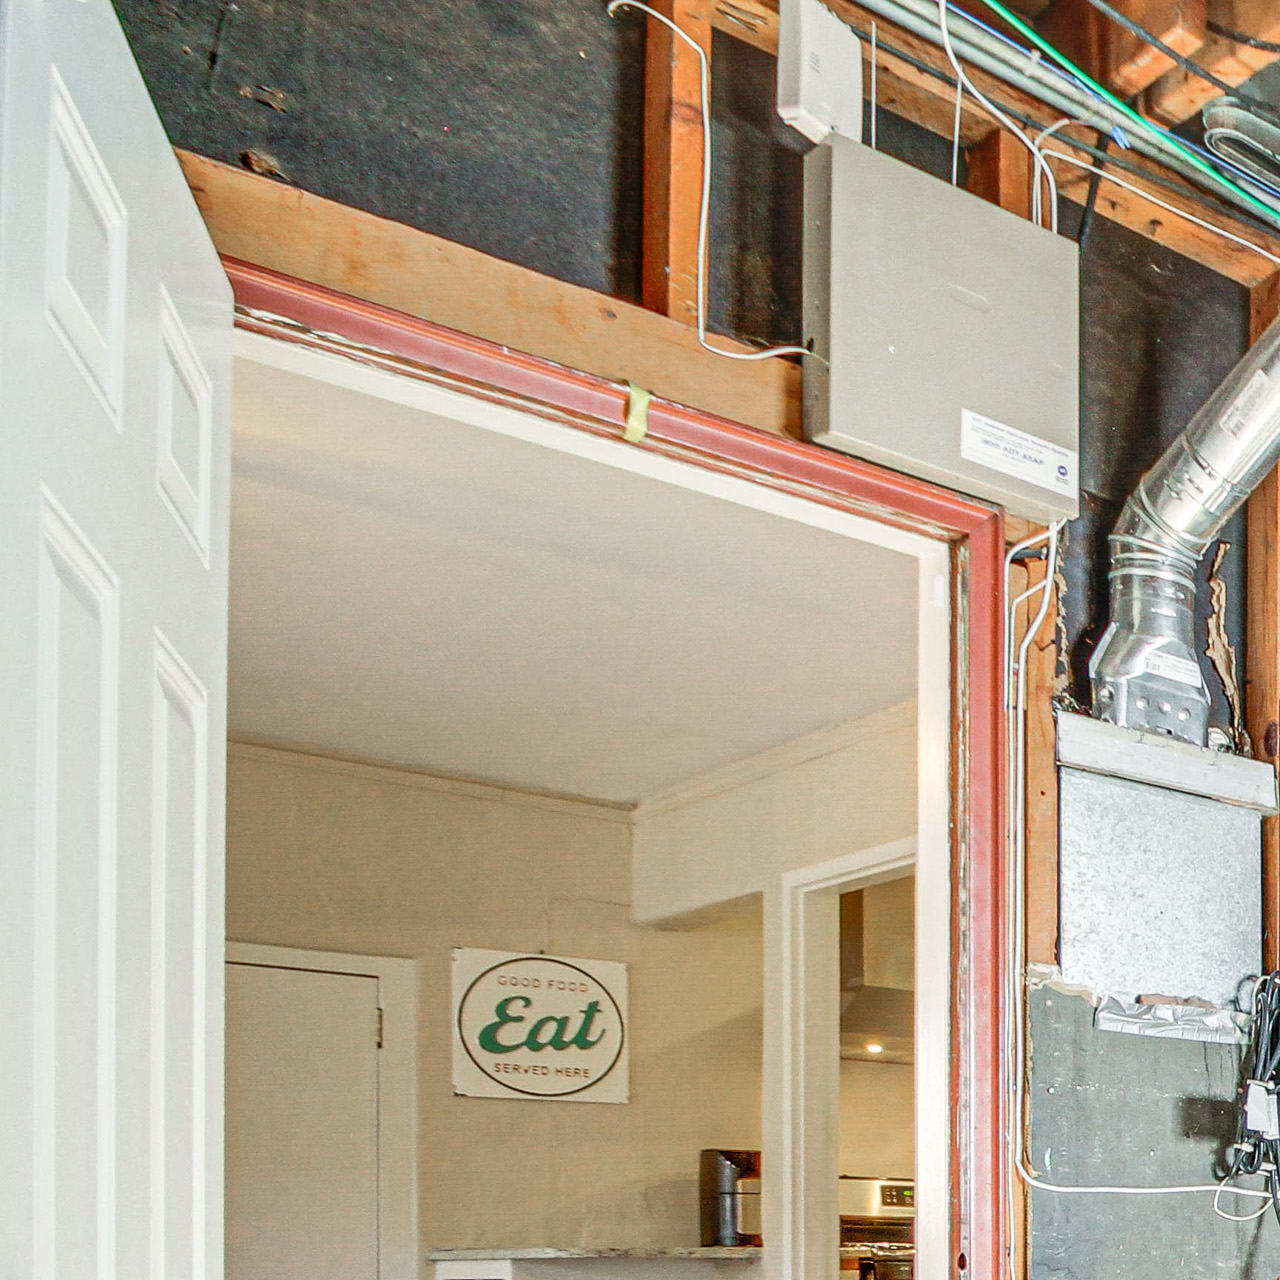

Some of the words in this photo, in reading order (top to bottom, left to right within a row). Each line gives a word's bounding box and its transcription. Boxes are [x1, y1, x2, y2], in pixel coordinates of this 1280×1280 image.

[497, 975, 541, 989] GOOD
[547, 980, 589, 993] FOOD
[478, 995, 607, 1055] Eat
[494, 1063, 549, 1077] SERVED
[555, 1067, 590, 1079] HERE
